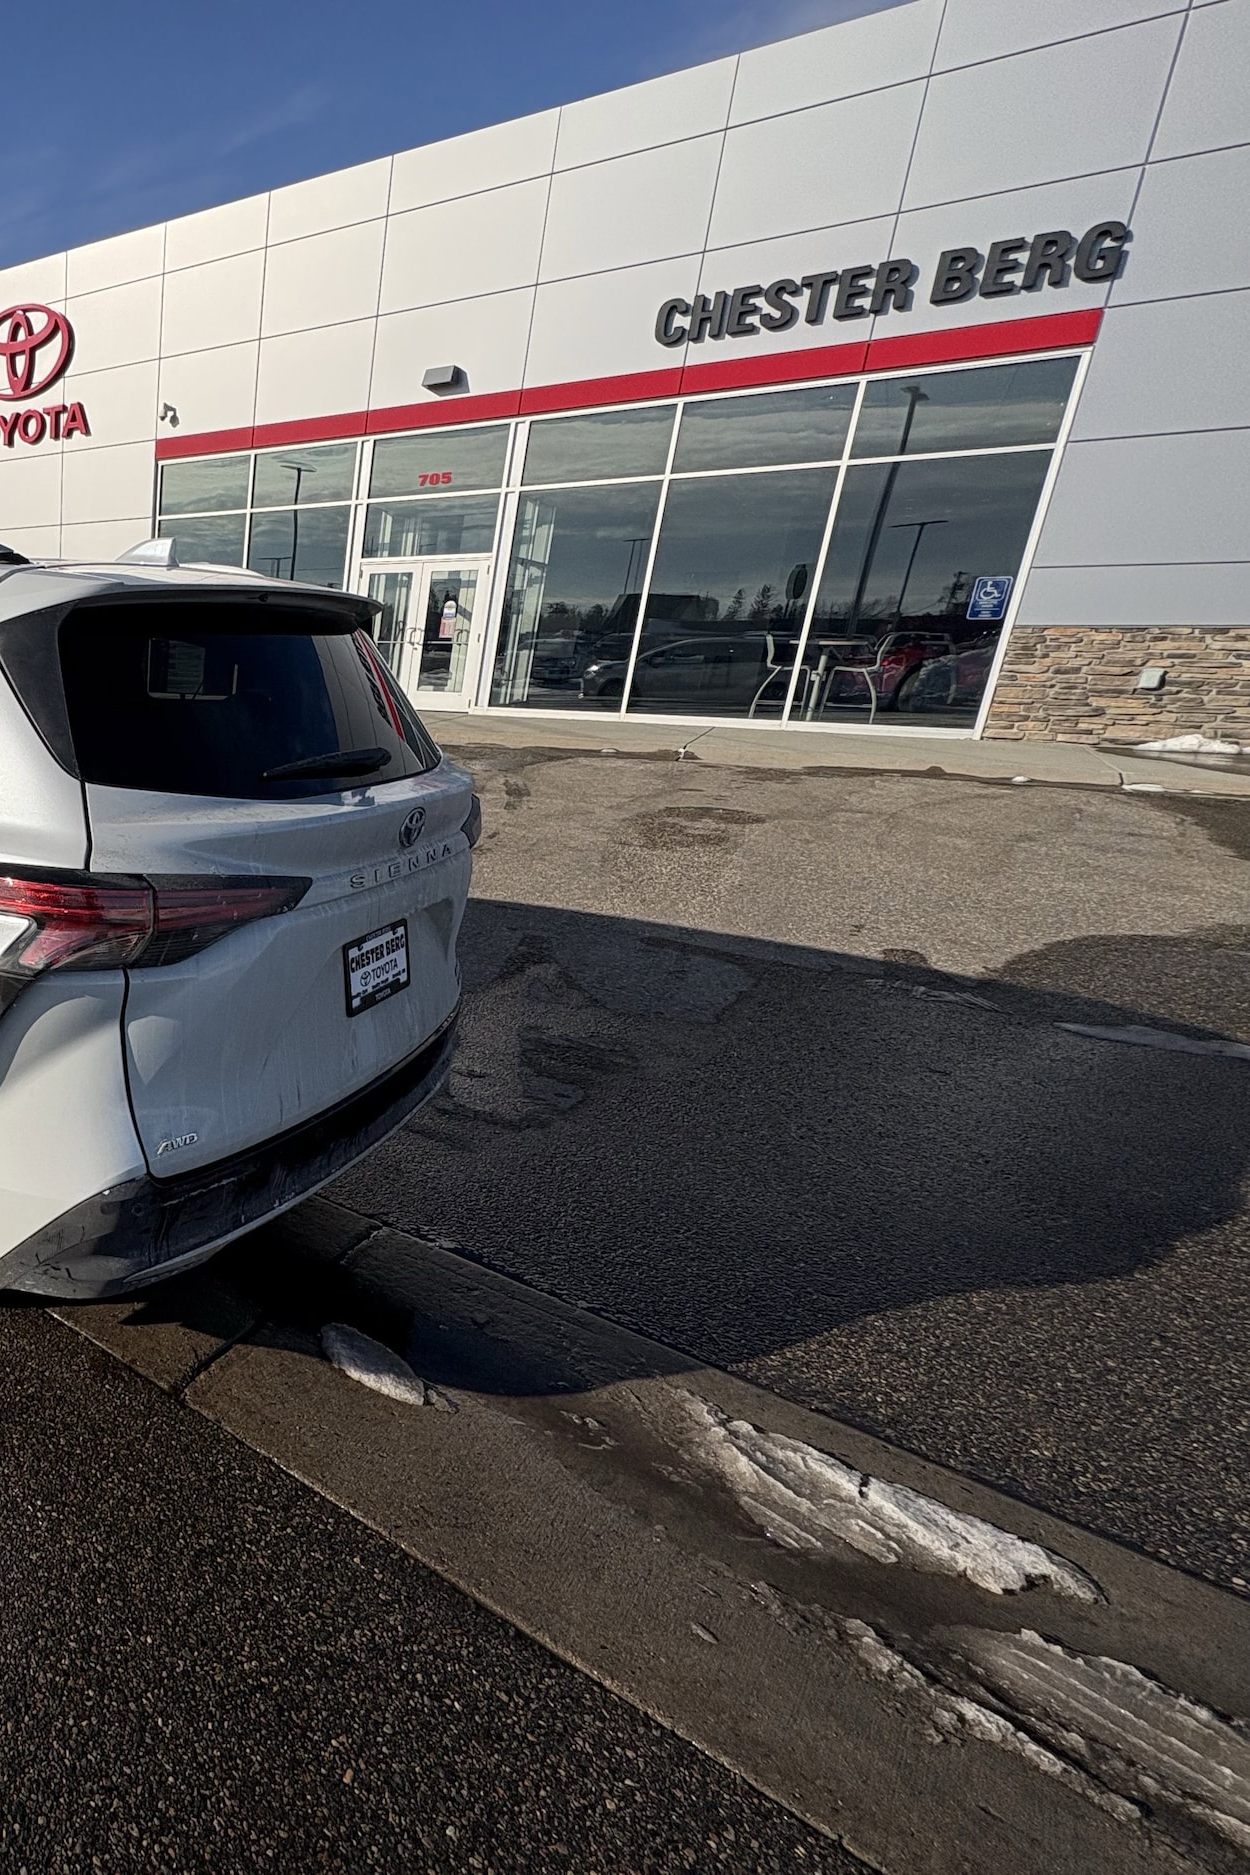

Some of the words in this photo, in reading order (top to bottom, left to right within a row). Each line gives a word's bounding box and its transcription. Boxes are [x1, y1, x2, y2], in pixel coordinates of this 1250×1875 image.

[655, 257, 920, 348] CHESTER
[930, 220, 1134, 306] BERG
[417, 471, 453, 487] 705
[350, 843, 452, 889] SIENNA
[350, 943, 385, 973] CHESTER
[385, 933, 405, 956] BERG
[371, 957, 398, 981] TOYOTA
[157, 1132, 198, 1155] AWD
